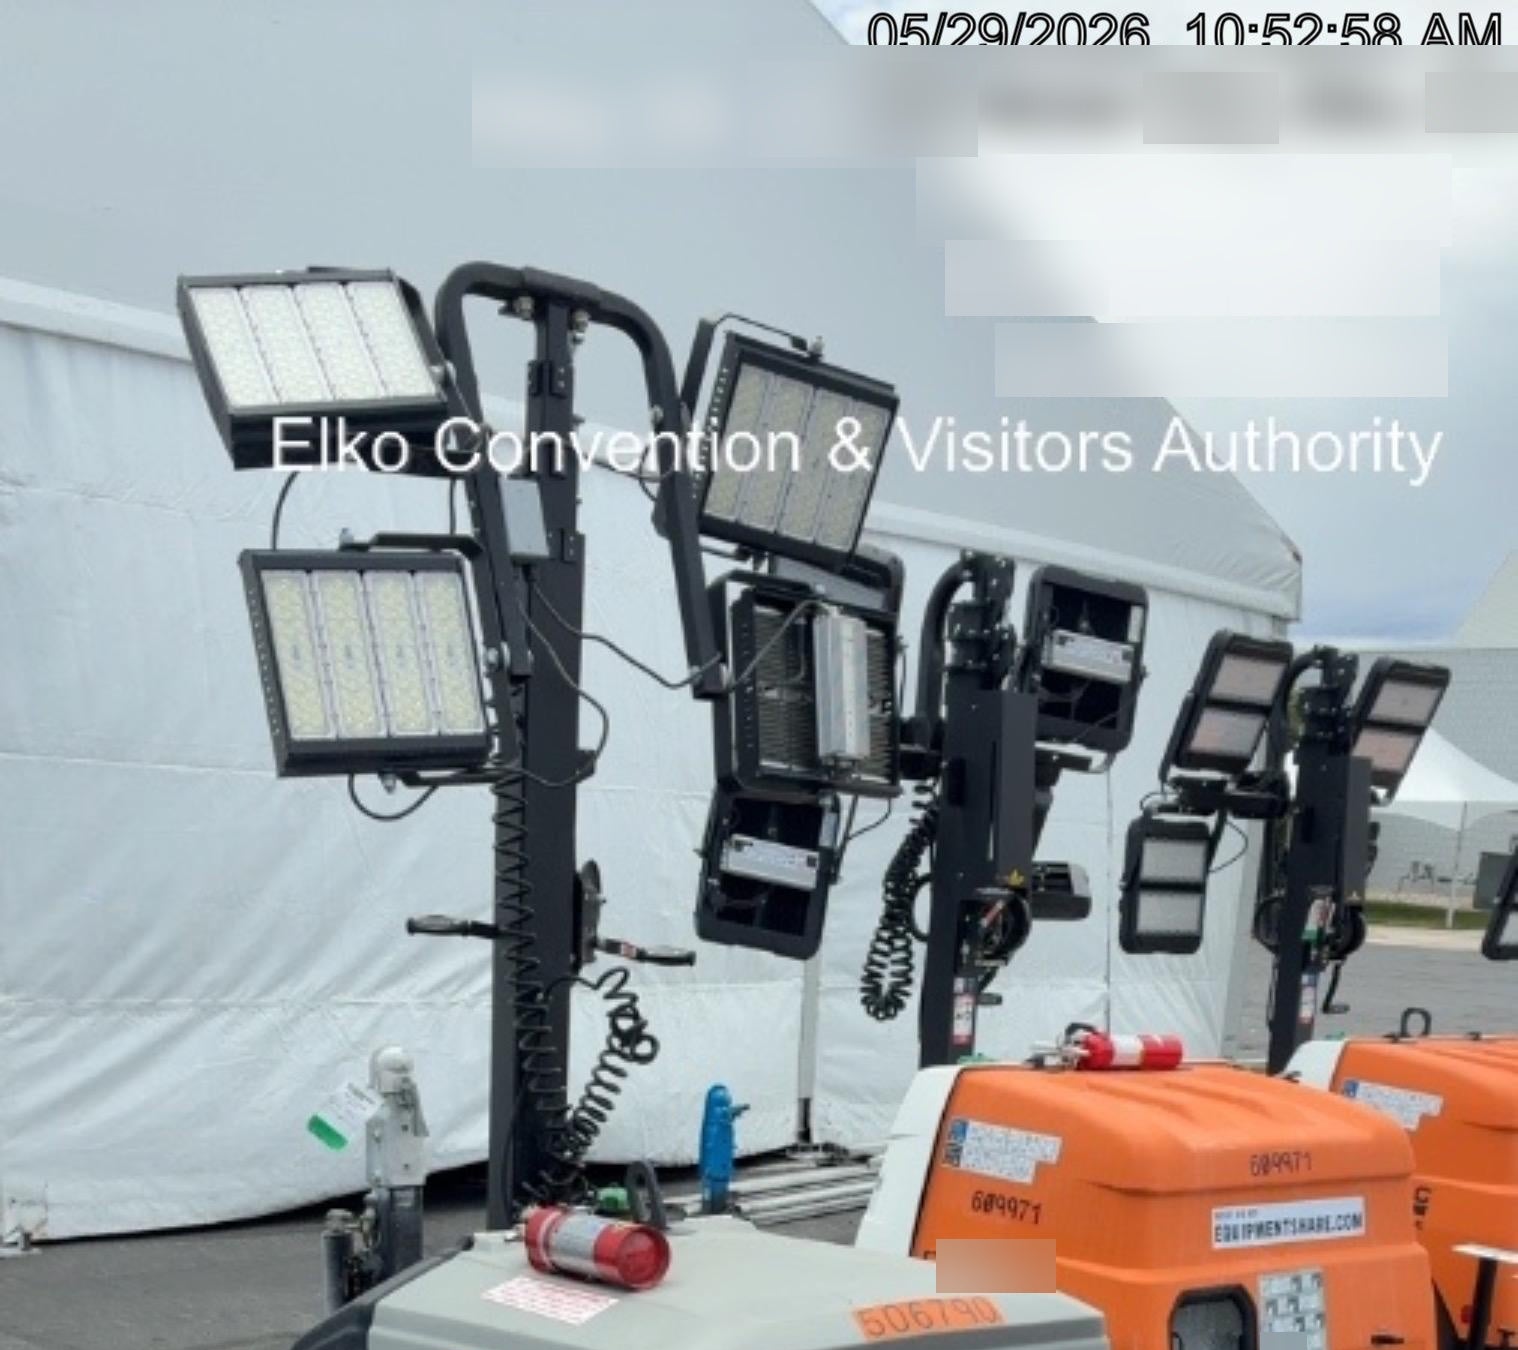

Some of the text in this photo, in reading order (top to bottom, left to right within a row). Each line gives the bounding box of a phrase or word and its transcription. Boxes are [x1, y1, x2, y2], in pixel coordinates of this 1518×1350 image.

[1249, 1151, 1313, 1177] 609971
[970, 1189, 1042, 1225] 609971
[1213, 1212, 1364, 1243] EQUIPMENTSHARE.COM
[857, 1296, 999, 1338] 506790
